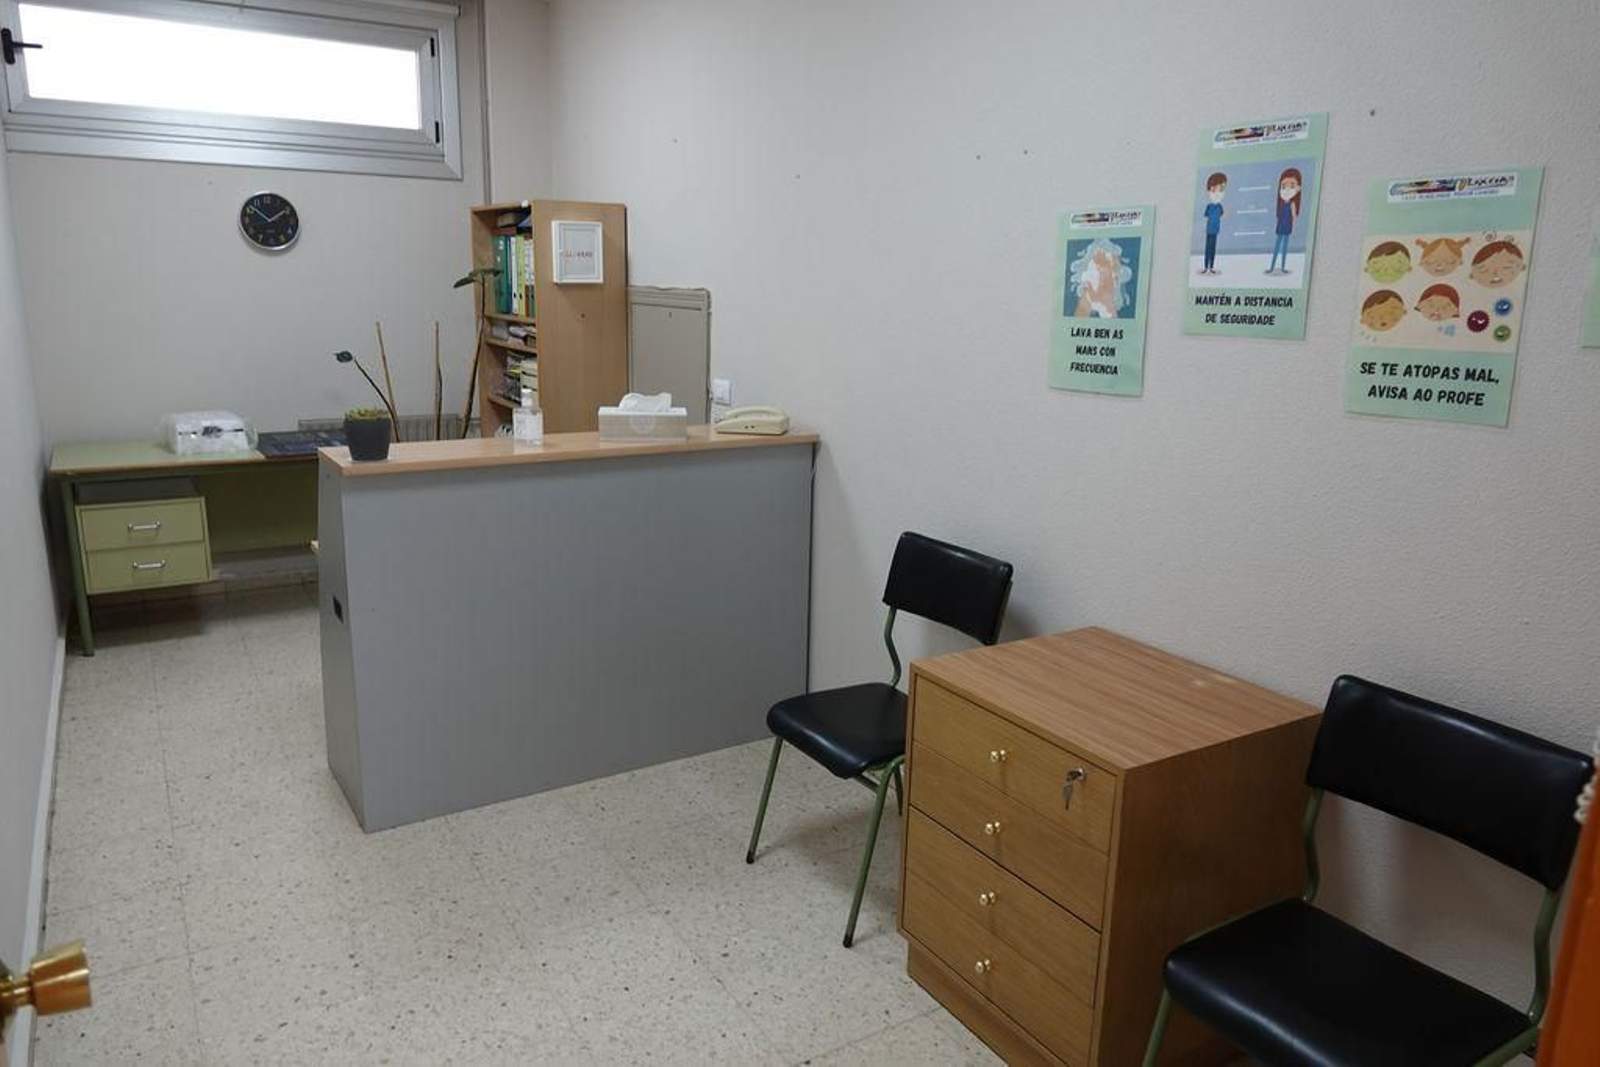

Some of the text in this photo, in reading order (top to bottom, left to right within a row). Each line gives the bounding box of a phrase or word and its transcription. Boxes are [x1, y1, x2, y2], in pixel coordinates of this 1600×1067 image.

[1195, 293, 1293, 308] MANTÉN A DISTANCIA
[1205, 313, 1275, 325] DE SEGURIDADE
[1070, 327, 1124, 340] LAVA BEN AS
[1075, 345, 1116, 357] MANS CON
[1070, 361, 1118, 375] FRECUENCIA
[1360, 361, 1500, 385] SE TE ATOPAS MAL,
[1367, 384, 1486, 407] AVISA AO PROFE
